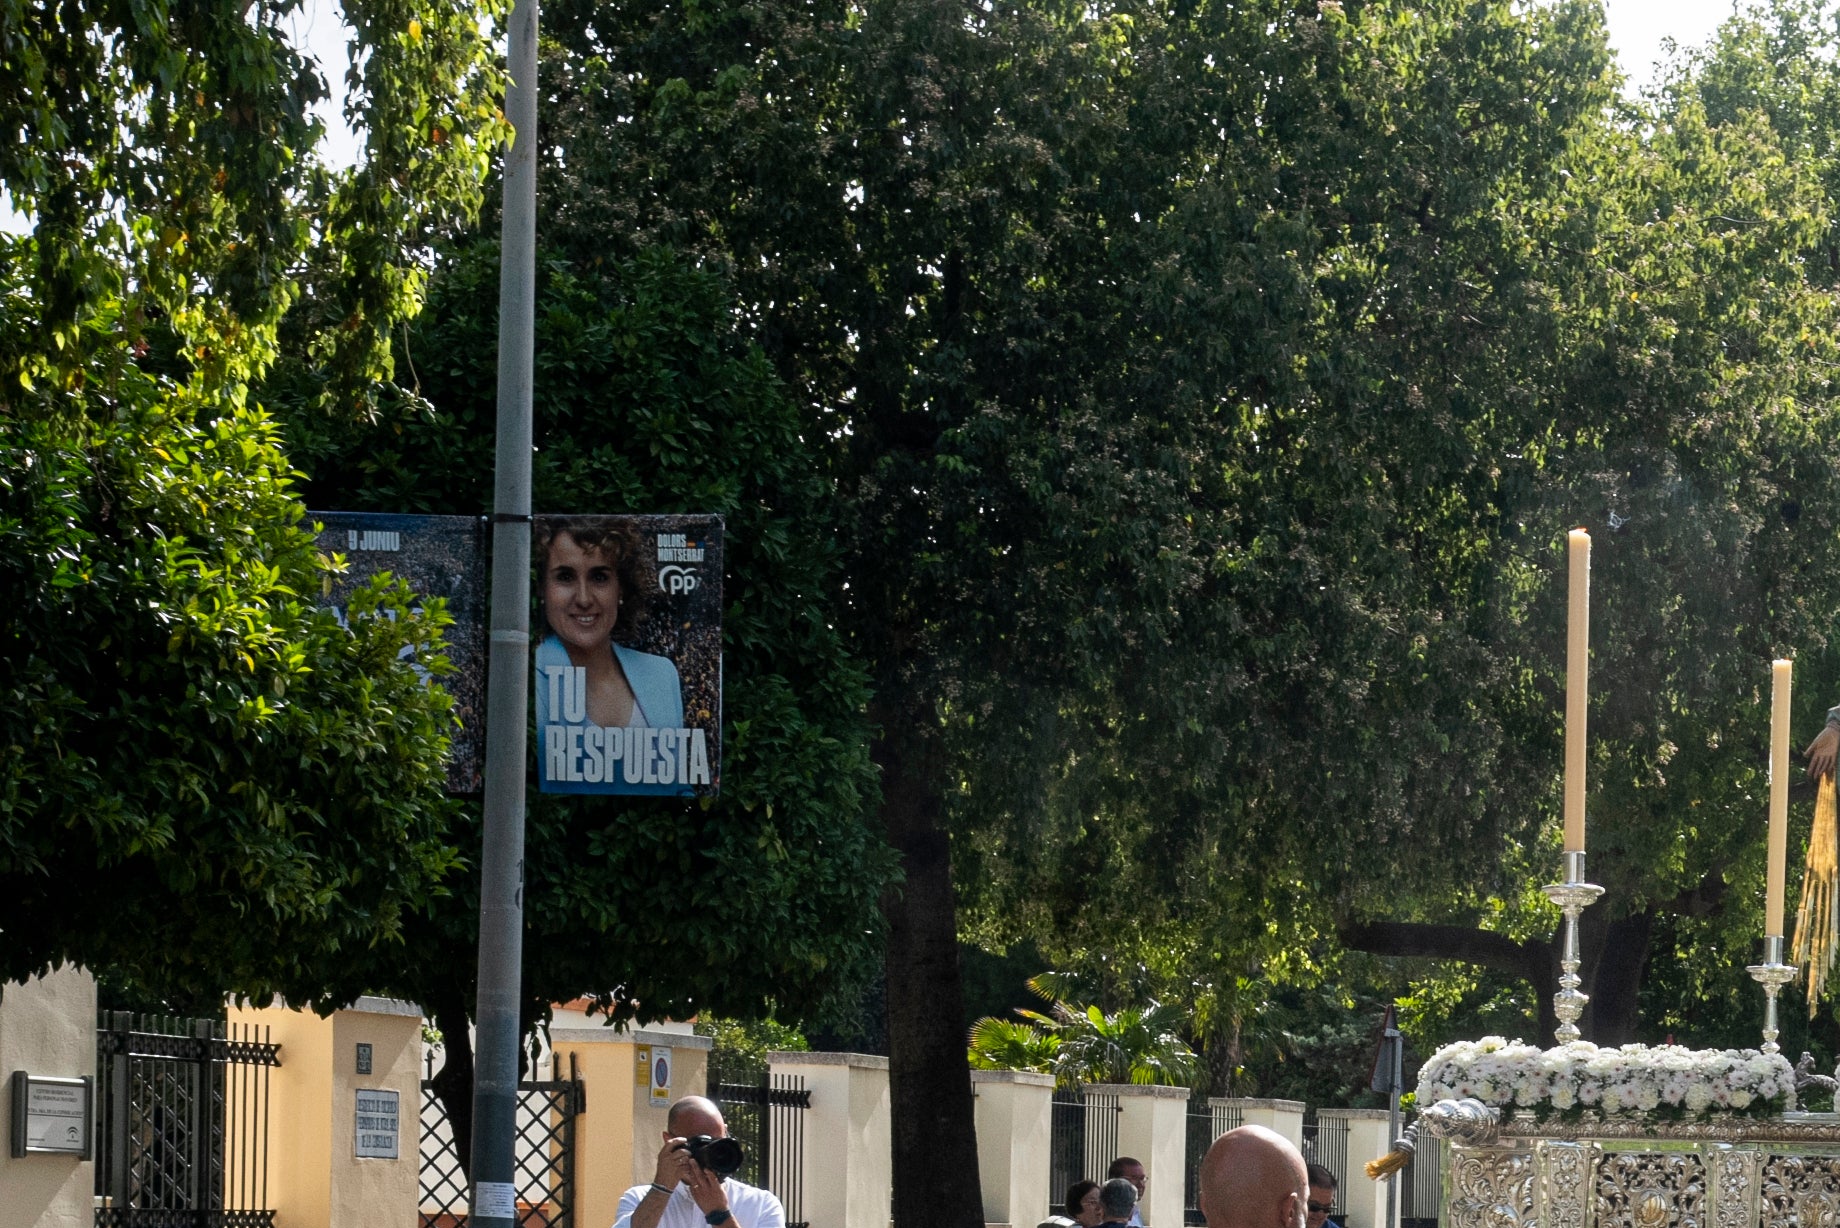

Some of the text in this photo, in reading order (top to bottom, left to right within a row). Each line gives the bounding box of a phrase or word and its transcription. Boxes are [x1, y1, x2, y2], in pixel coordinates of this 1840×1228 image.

[348, 530, 358, 550] 9
[657, 534, 687, 547] DOLORS
[545, 666, 586, 723] TU
[545, 725, 711, 785] RESPUESTA
